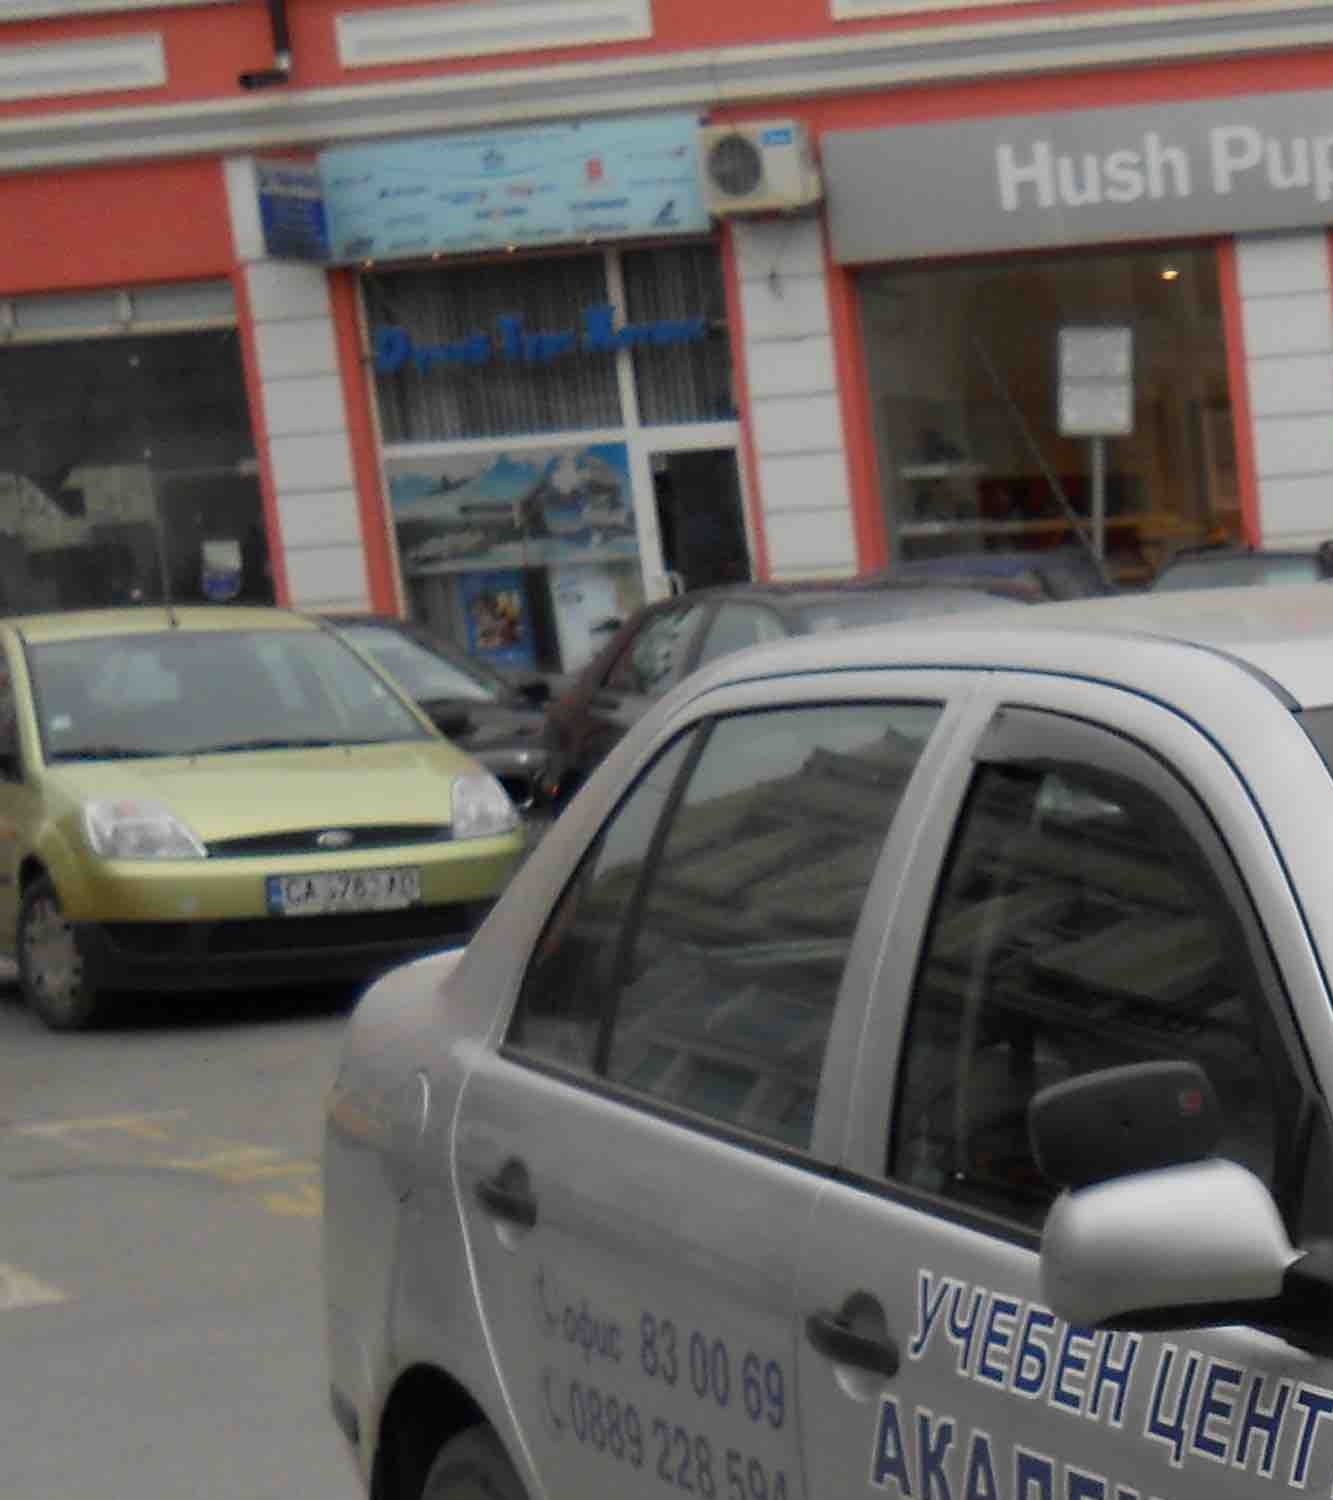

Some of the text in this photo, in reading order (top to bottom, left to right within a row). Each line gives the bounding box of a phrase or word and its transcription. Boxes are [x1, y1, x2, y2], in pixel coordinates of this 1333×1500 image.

[995, 131, 1192, 212] Hush
[639, 1310, 678, 1388] 83
[689, 1330, 731, 1407] 00
[741, 1350, 786, 1430] 69
[908, 1268, 1142, 1429] УЧЕБЕН
[569, 1379, 644, 1469] 0889
